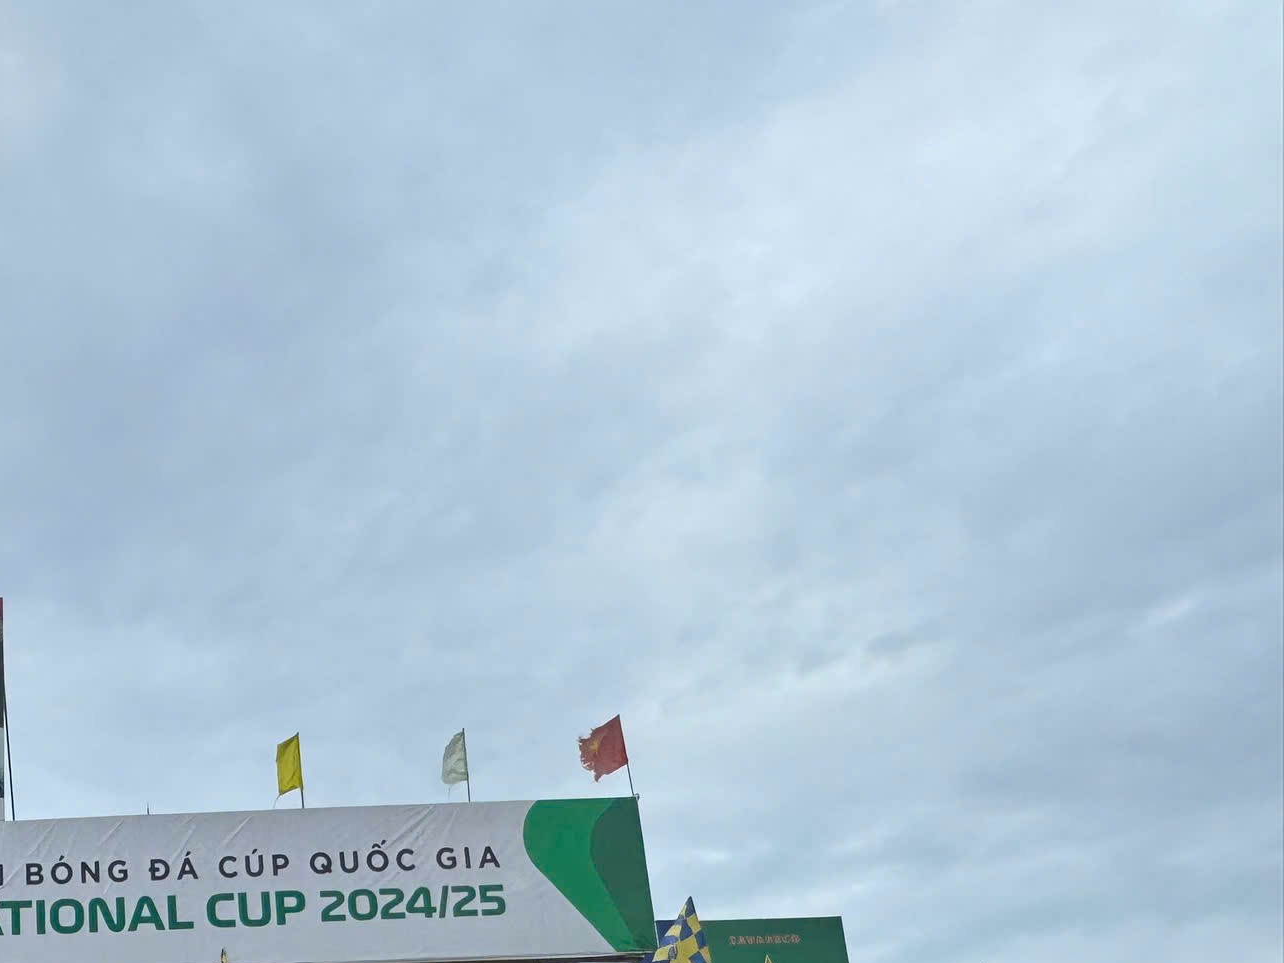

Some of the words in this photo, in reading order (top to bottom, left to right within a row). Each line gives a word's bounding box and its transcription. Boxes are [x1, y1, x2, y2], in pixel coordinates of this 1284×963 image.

[26, 854, 129, 886] BÓNG
[148, 851, 198, 881] ĐÁ
[218, 848, 290, 879] CÚP
[309, 839, 416, 874] QUỐC
[436, 846, 501, 871] GIA
[206, 891, 306, 928] CUP
[319, 884, 508, 923] 2024/25
